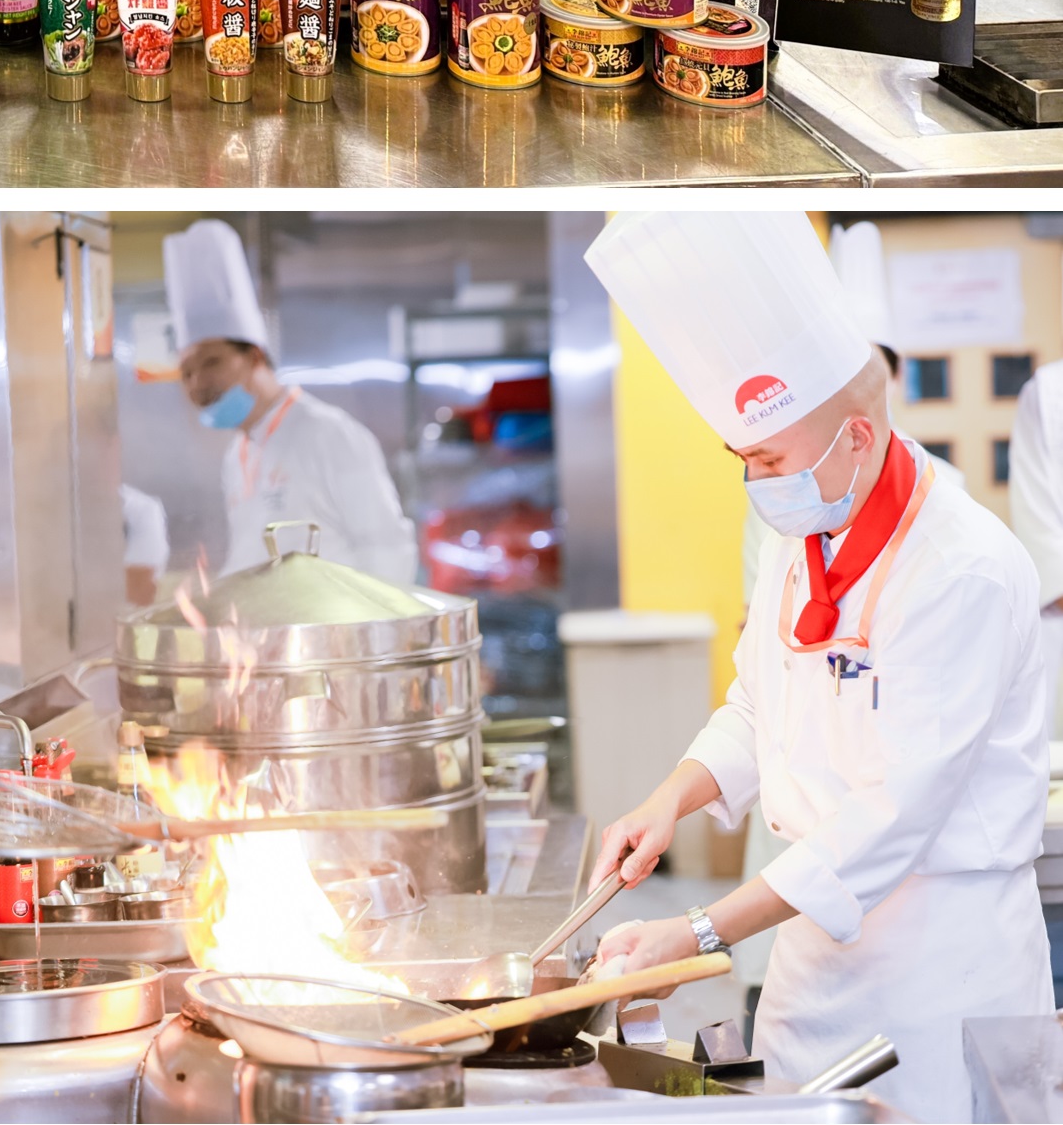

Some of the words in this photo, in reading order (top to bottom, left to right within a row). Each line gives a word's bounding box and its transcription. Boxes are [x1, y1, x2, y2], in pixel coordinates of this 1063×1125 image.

[595, 44, 633, 70] 鮑魚
[709, 64, 749, 92] 鮑魚
[743, 414, 759, 427] LEE
[758, 403, 779, 419] KUM
[778, 392, 796, 408] KEE
